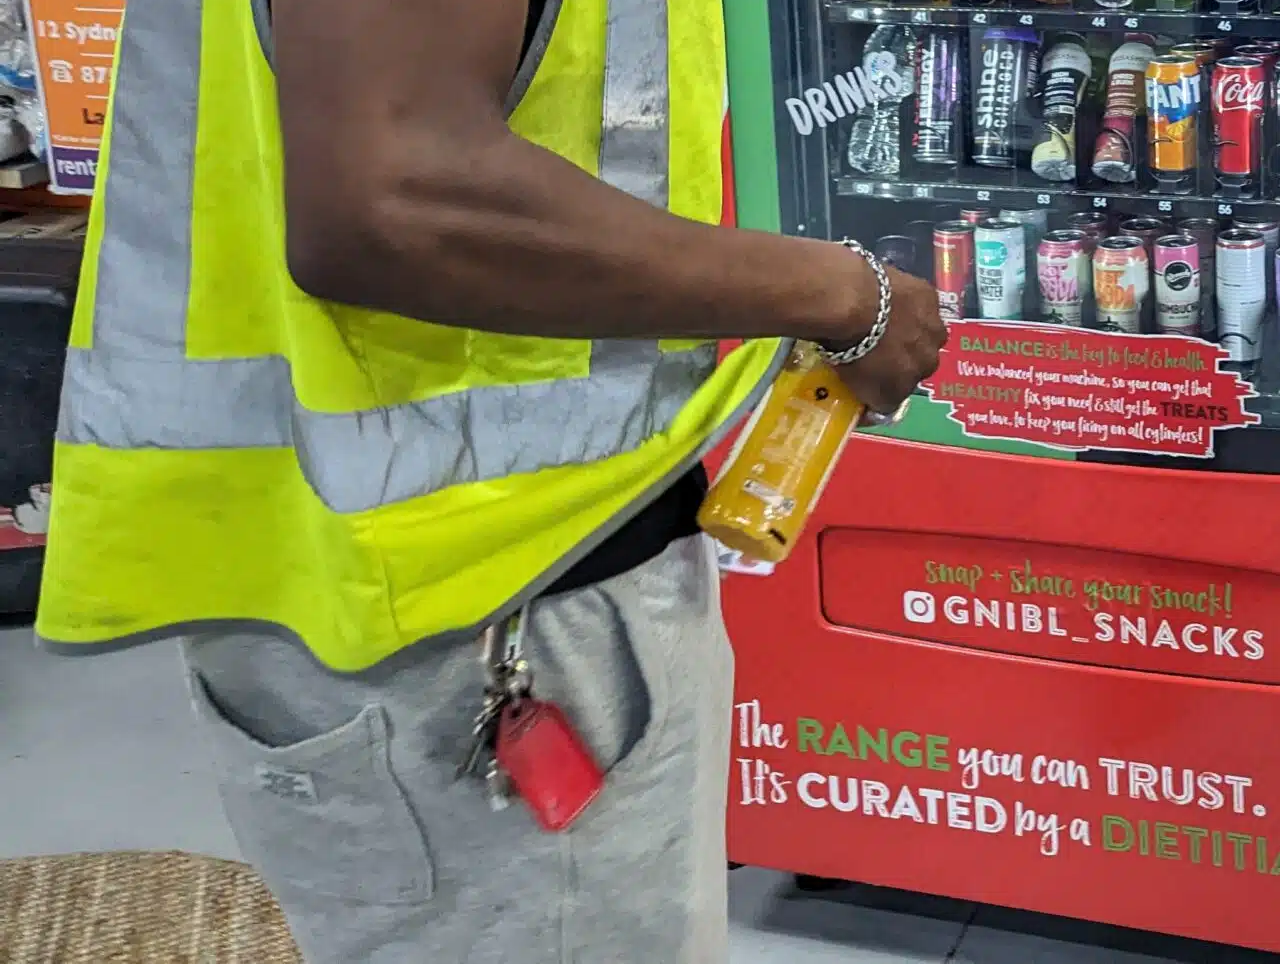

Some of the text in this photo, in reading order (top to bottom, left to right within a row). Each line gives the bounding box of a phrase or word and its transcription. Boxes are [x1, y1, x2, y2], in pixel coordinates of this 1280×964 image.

[973, 14, 986, 23] 42
[1020, 15, 1033, 25] 43
[1092, 17, 1106, 27] 44
[1125, 18, 1138, 28] 45
[1218, 21, 1231, 31] 46
[37, 20, 60, 39] 12
[785, 52, 902, 136] DRINKS
[977, 49, 998, 128] shine
[994, 50, 1014, 127] CHARGED
[56, 159, 98, 177] rent
[978, 191, 990, 201] 52
[1038, 194, 1050, 204] 53
[1093, 197, 1106, 208] 54
[1159, 201, 1172, 212] 55
[1218, 205, 1232, 215] 56
[960, 337, 1044, 357] BALANCE
[1046, 345, 1057, 358] is
[1061, 341, 1079, 360] the
[1083, 343, 1104, 367] key
[1108, 347, 1119, 365] to
[1124, 347, 1149, 370] food
[1152, 350, 1162, 367] &
[988, 363, 1033, 382] balanced
[1035, 372, 1060, 385] your
[1128, 379, 1149, 394] you
[1151, 381, 1171, 392] can
[1172, 380, 1189, 399] get
[1191, 380, 1212, 397] that
[941, 382, 1228, 421] HEALTHY fix you need & still get the TREATS
[968, 412, 987, 425] you
[1014, 411, 1025, 427] to
[1027, 412, 1050, 431] keep
[1052, 419, 1076, 435] you
[1078, 417, 1108, 441] firing
[1110, 425, 1126, 435] on
[1128, 421, 1144, 440] all
[1145, 423, 1203, 444] cylinders!
[991, 570, 1002, 581] +
[1083, 577, 1141, 612] your
[944, 595, 1265, 661] GNIBL_SNACKS
[735, 699, 1267, 817] The RANGE you can TRUST.
[736, 757, 792, 806] It's
[797, 772, 1007, 835] CURATED
[1014, 800, 1065, 856] by
[1070, 818, 1091, 847] a
